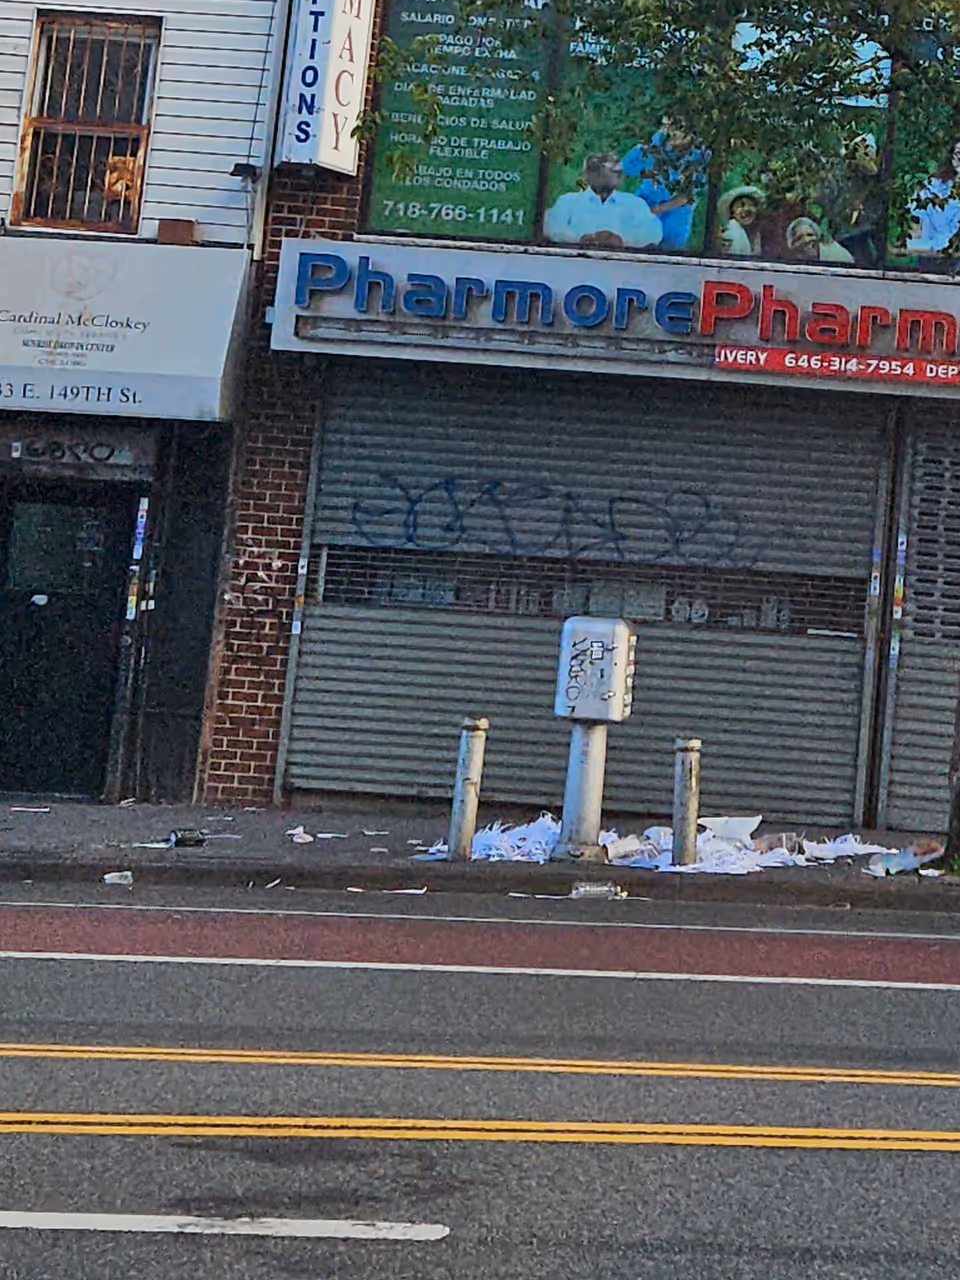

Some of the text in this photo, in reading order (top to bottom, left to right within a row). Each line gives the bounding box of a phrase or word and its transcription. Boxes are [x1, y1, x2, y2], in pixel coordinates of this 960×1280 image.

[400, 11, 456, 25] SALARIO
[450, 136, 468, 148] DE
[474, 137, 532, 151] TRABAJO
[479, 169, 521, 182] TODOS
[434, 178, 507, 192] CONDADOS
[383, 199, 525, 226] 718-766-1141
[65, 311, 151, 334] McCloskey
[784, 352, 916, 378] 646-314-7954
[21, 382, 40, 400] E.
[49, 384, 112, 403] 149TH
